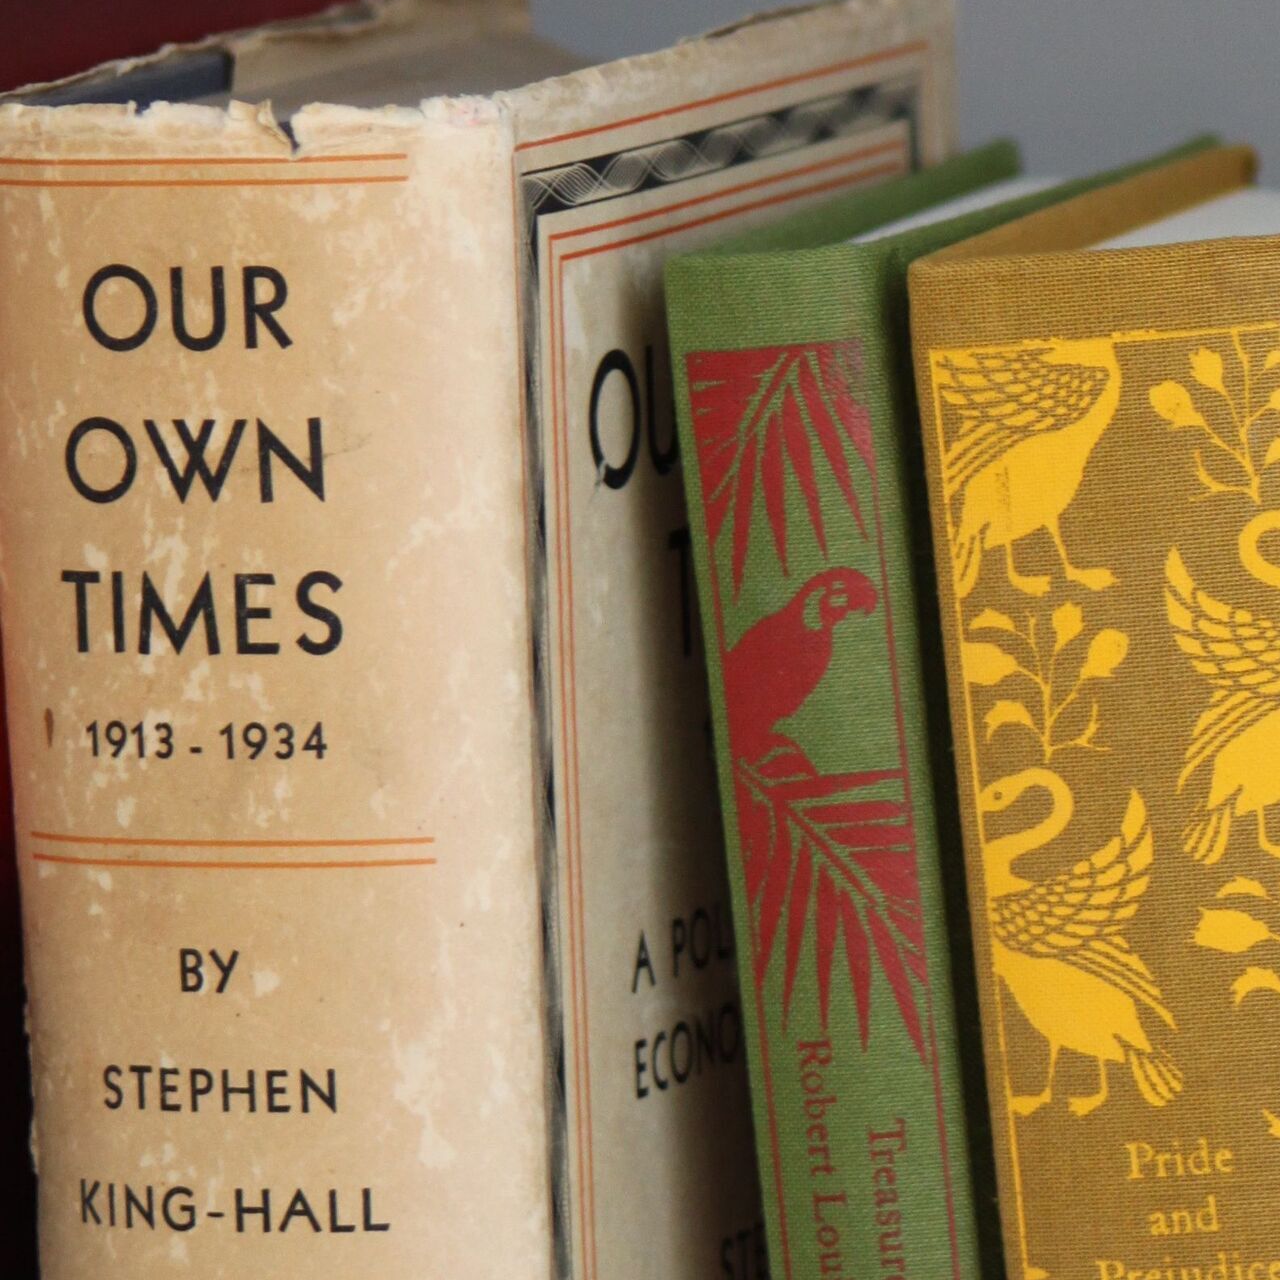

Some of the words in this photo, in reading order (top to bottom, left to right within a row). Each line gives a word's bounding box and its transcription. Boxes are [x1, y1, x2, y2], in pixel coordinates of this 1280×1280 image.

[82, 263, 293, 352] OUR
[64, 416, 325, 504] OWN
[588, 344, 681, 490] OU
[61, 570, 344, 656] TIMES
[179, 948, 240, 994] BY
[630, 928, 657, 995] A
[672, 901, 734, 979] POL
[102, 1064, 339, 1114] STEPHEN
[633, 1001, 742, 1100] ECONO
[796, 1039, 838, 1178] Robert
[1124, 1135, 1235, 1180] Pride
[79, 1177, 391, 1234] KING-HALL
[1149, 1194, 1222, 1237] and
